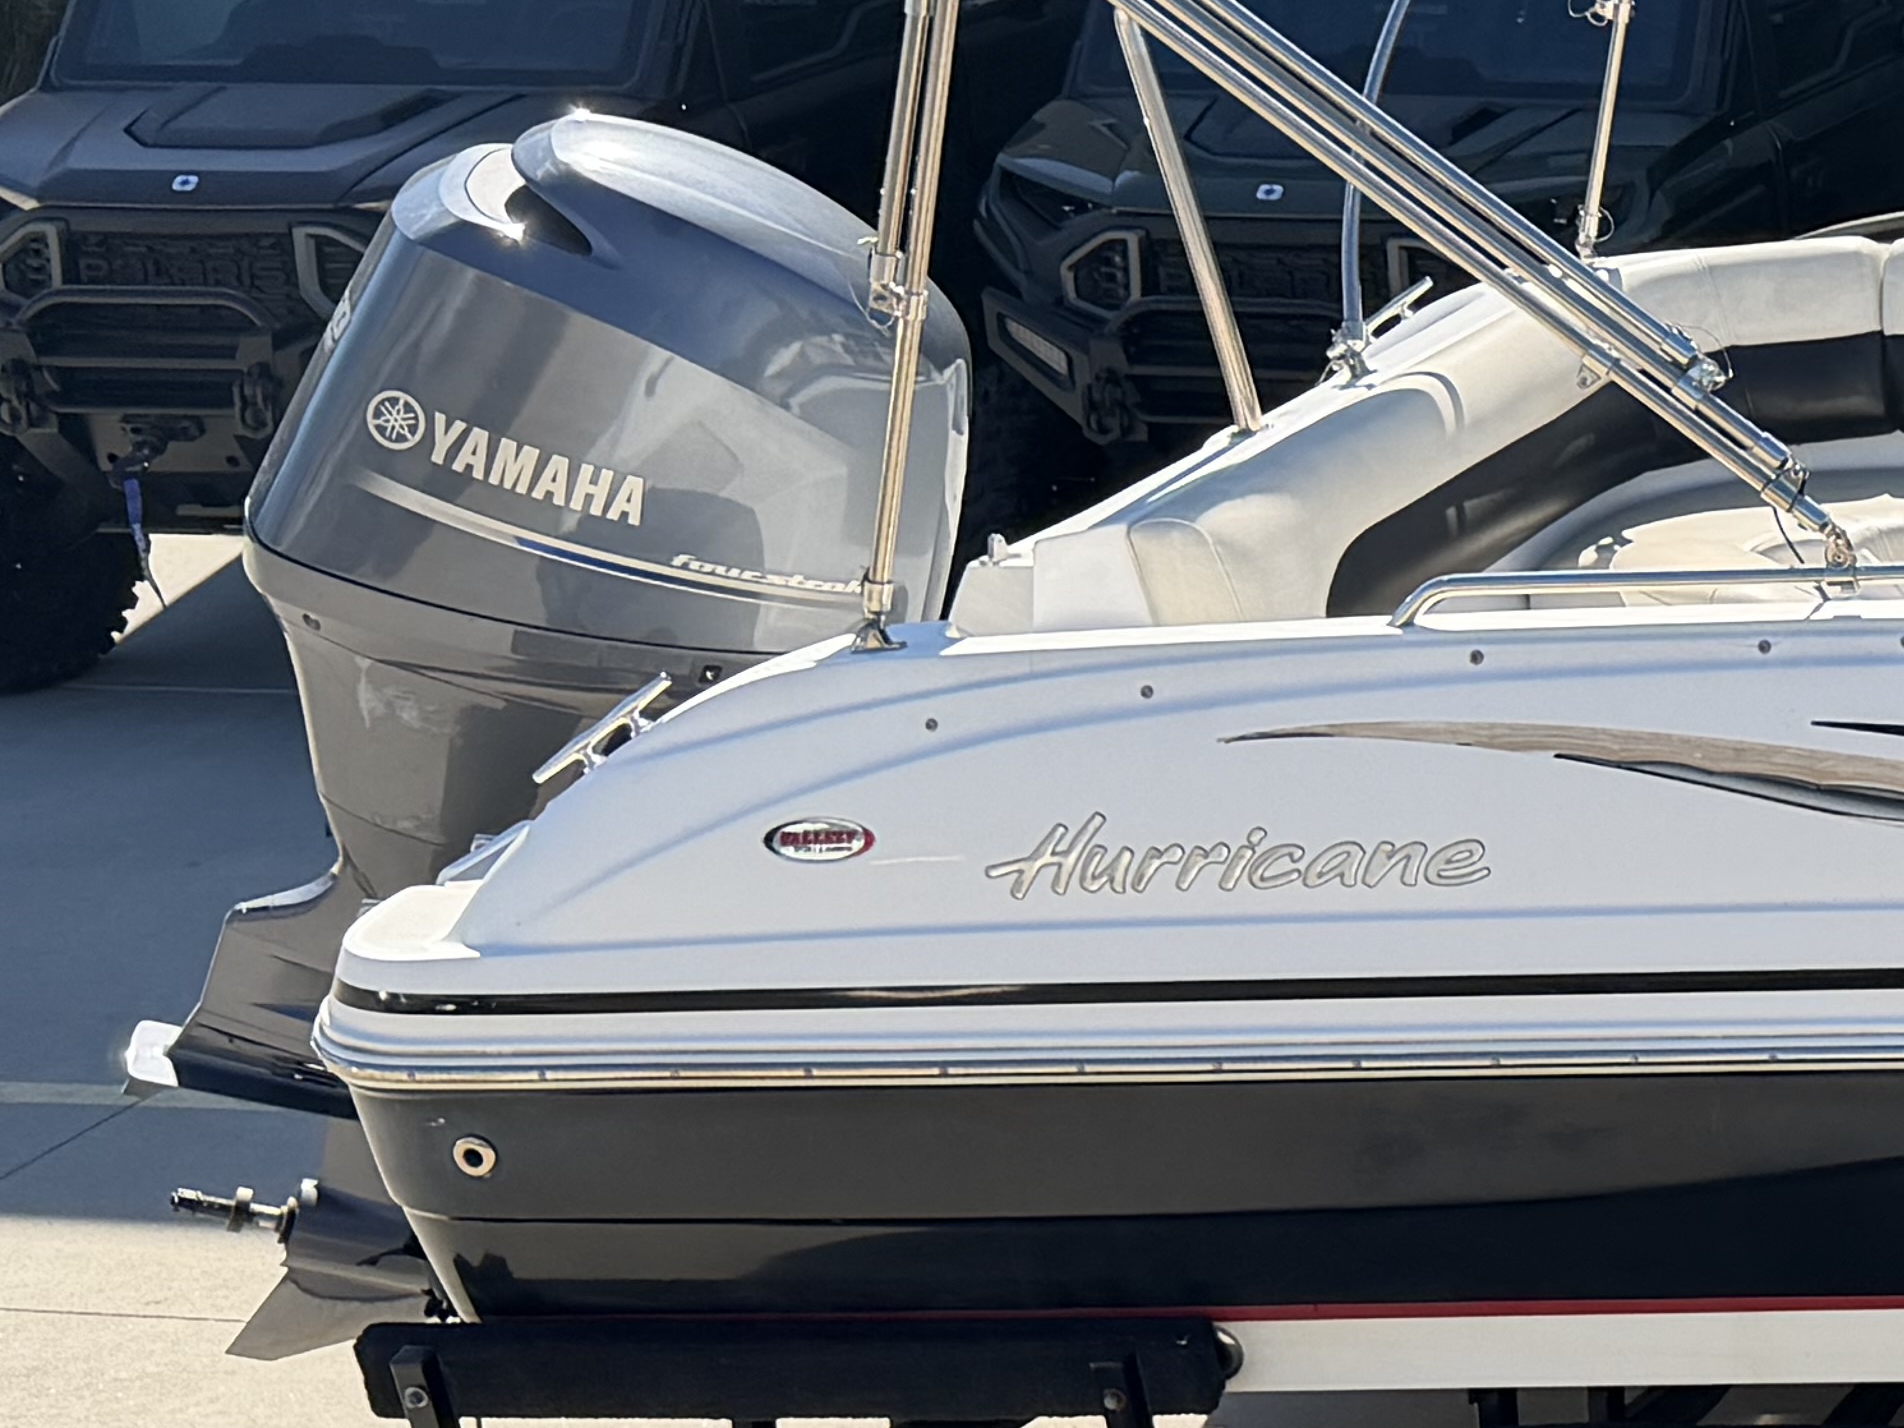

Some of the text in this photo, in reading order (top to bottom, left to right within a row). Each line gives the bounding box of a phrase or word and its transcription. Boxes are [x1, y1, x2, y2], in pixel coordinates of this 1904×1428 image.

[430, 410, 645, 527] YAMAHA
[668, 553, 863, 595] fourstrok
[984, 811, 1492, 900] Hurricane
